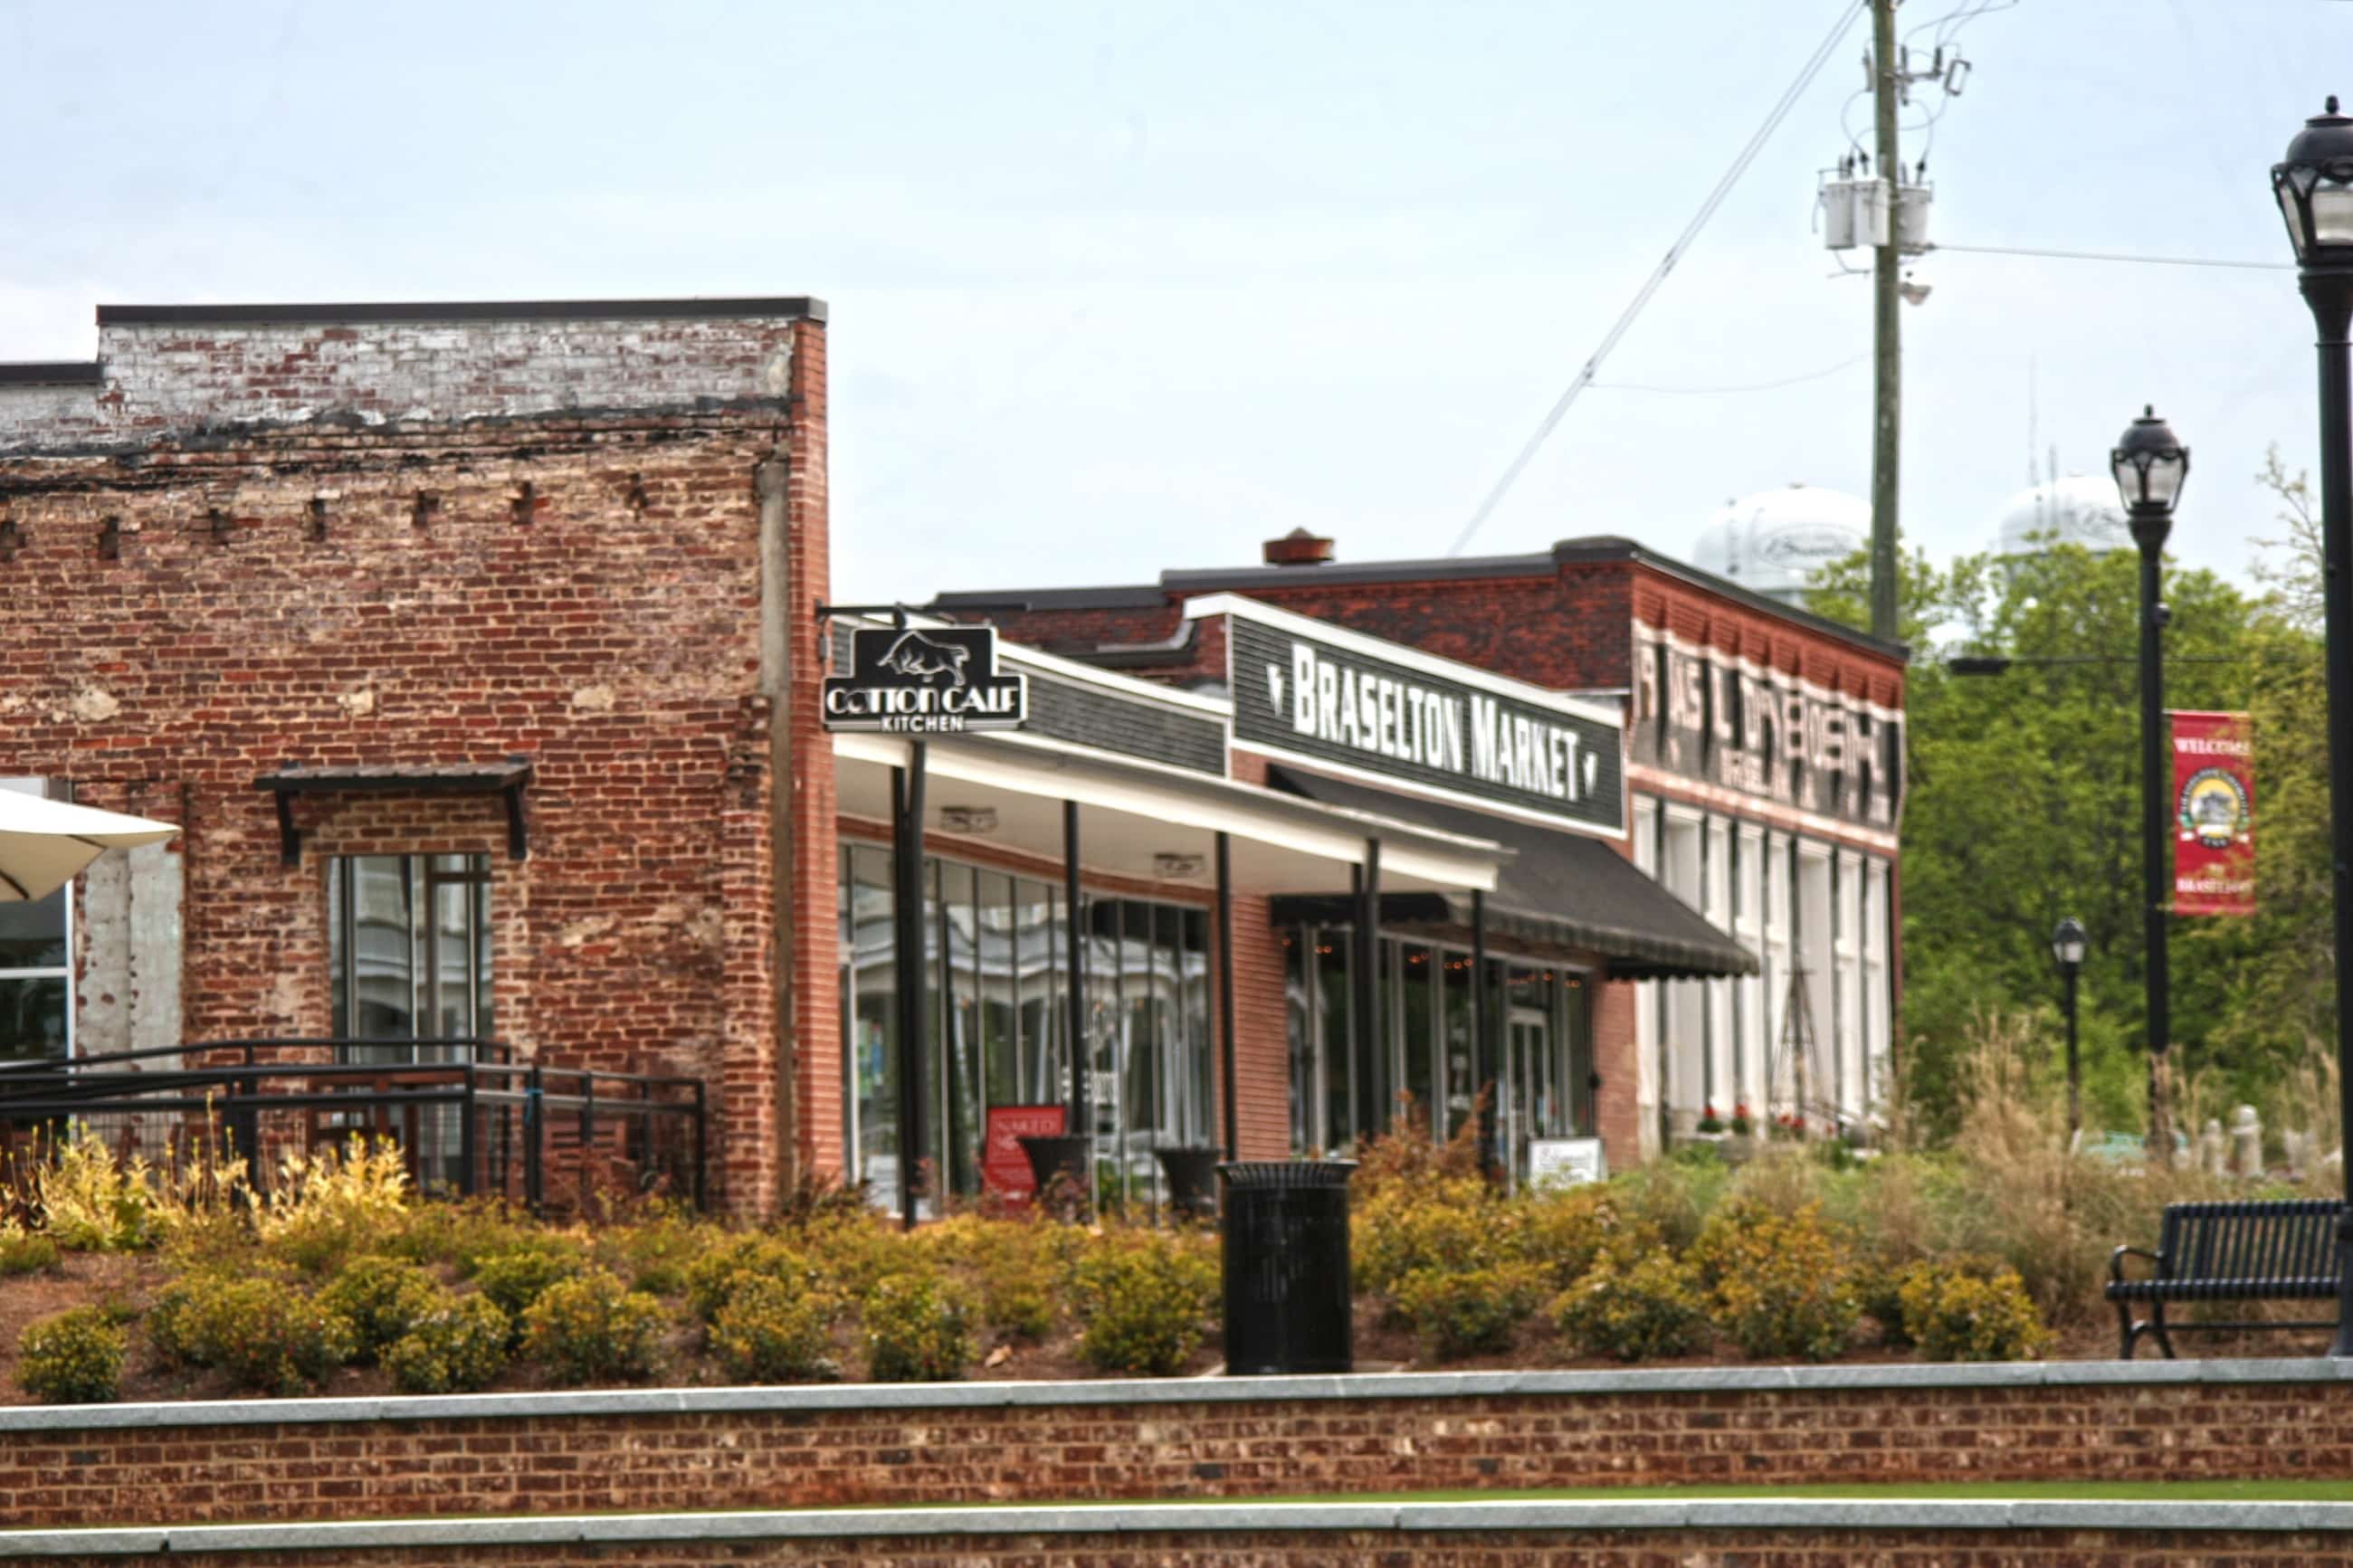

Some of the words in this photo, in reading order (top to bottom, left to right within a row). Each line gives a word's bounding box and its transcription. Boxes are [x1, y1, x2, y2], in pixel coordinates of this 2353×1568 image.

[825, 687, 939, 714] COTTON
[942, 687, 1019, 713] CALF
[881, 716, 965, 732] KITCHEN
[1291, 641, 1464, 774] BRASELTON
[1469, 694, 1581, 803] MARKET
